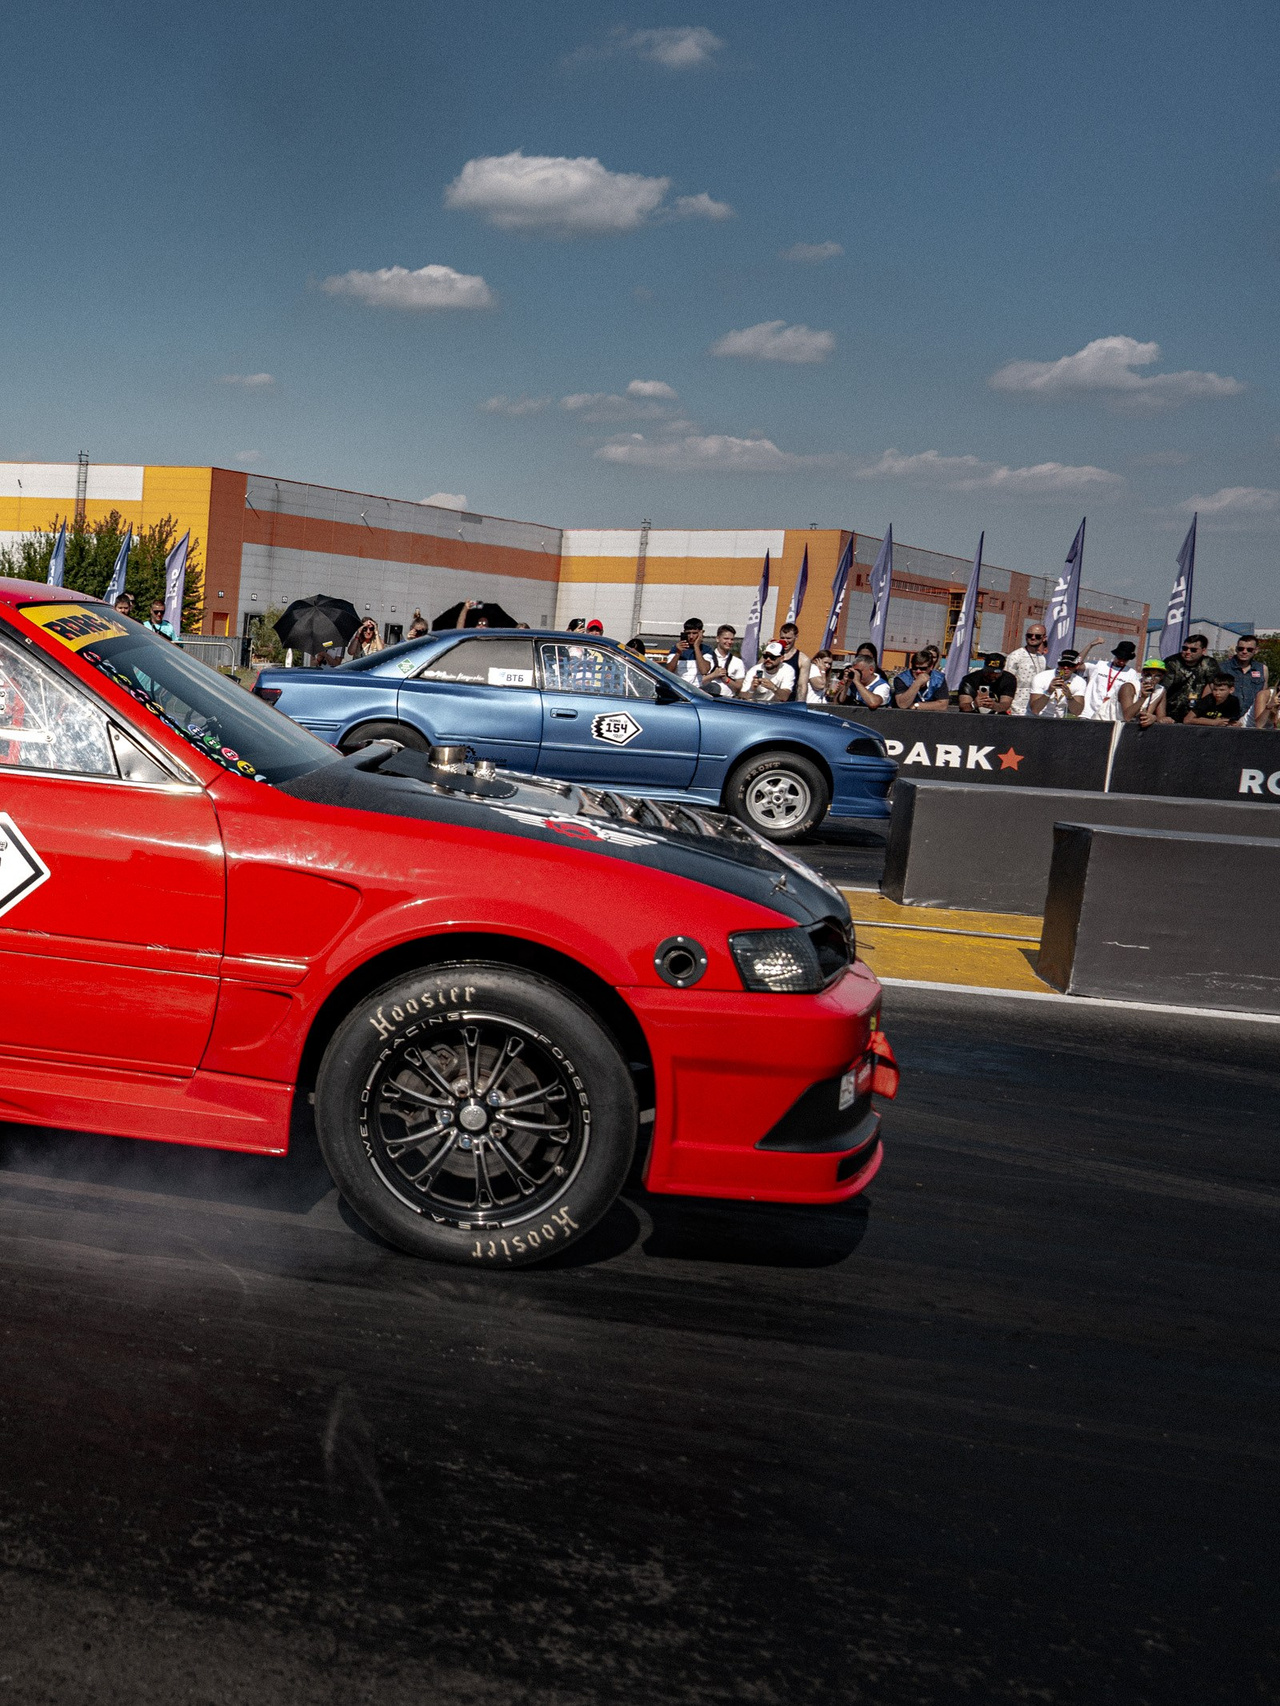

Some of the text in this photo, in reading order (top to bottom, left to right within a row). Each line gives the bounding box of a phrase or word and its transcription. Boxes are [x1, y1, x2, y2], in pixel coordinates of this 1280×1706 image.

[506, 674, 524, 683] ВТБ
[605, 722, 628, 734] 154
[369, 982, 477, 1041] Hoosier
[359, 1012, 591, 1231] WELD RACING FORGED USA
[471, 1205, 580, 1261] Hoosier
